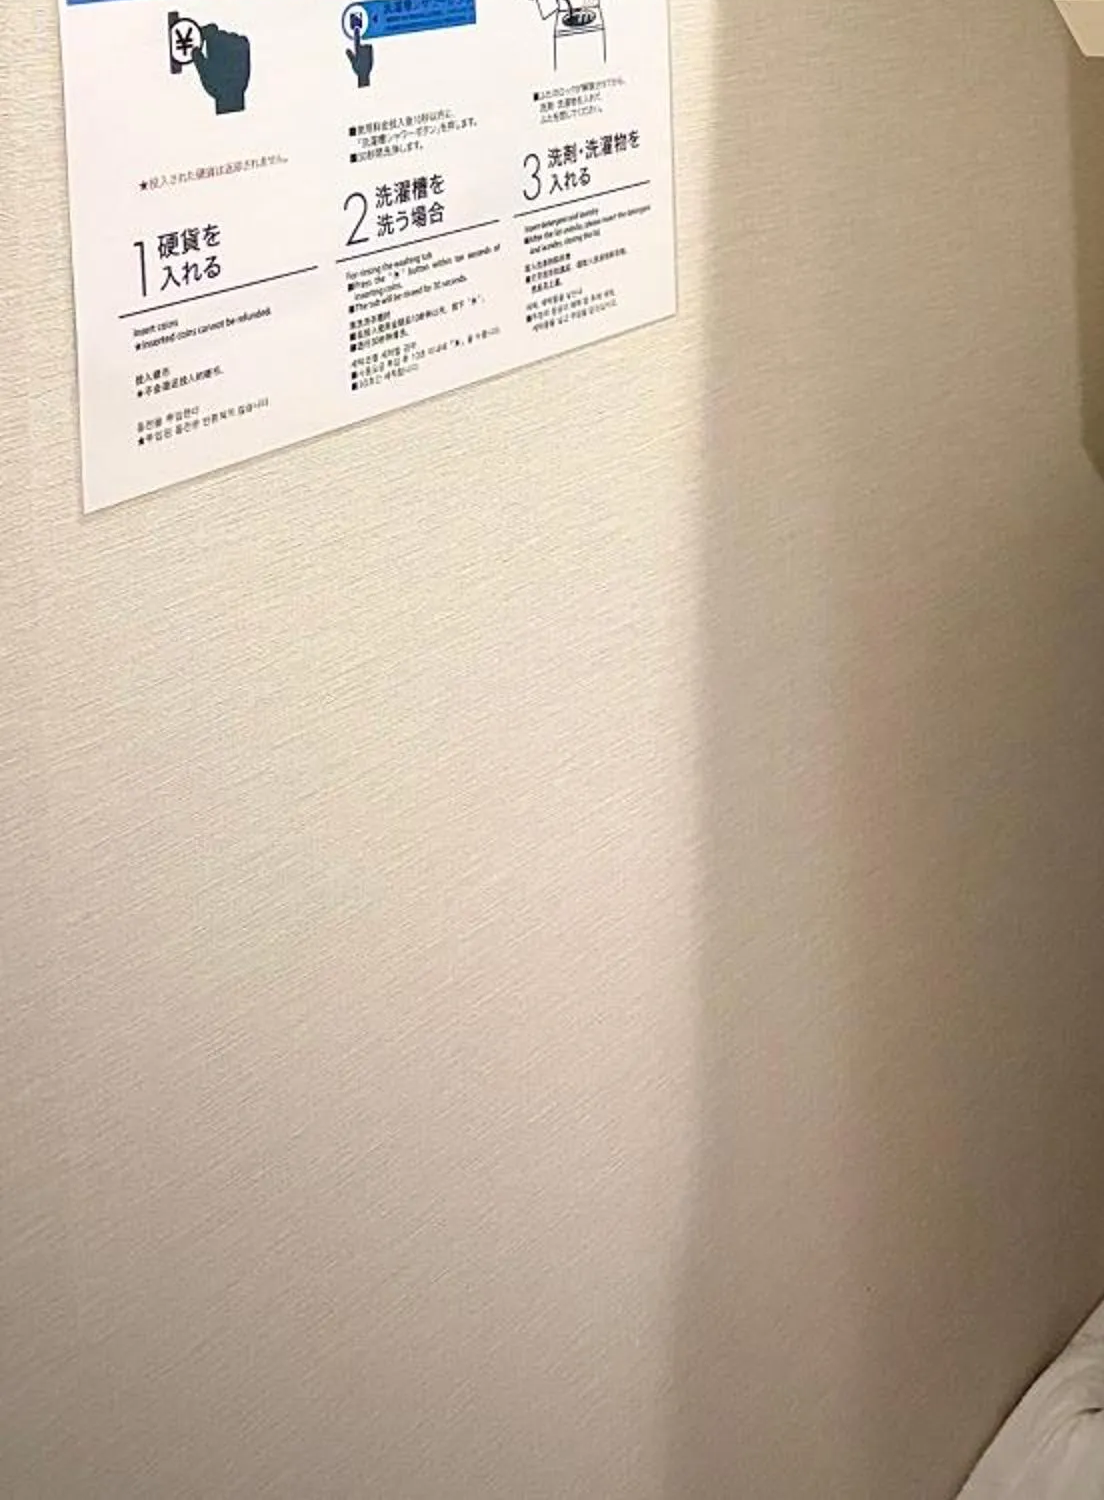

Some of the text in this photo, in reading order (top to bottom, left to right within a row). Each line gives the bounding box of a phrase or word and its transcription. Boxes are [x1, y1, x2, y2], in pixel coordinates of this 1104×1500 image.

[524, 130, 640, 200] 3 洗剤・洗濯物を
[550, 167, 591, 195] 入れる
[343, 173, 446, 247] 2 洗濯槽を
[376, 201, 445, 237] 洗う場合
[156, 223, 221, 260] 硬貨を
[159, 255, 222, 292] 入れる
